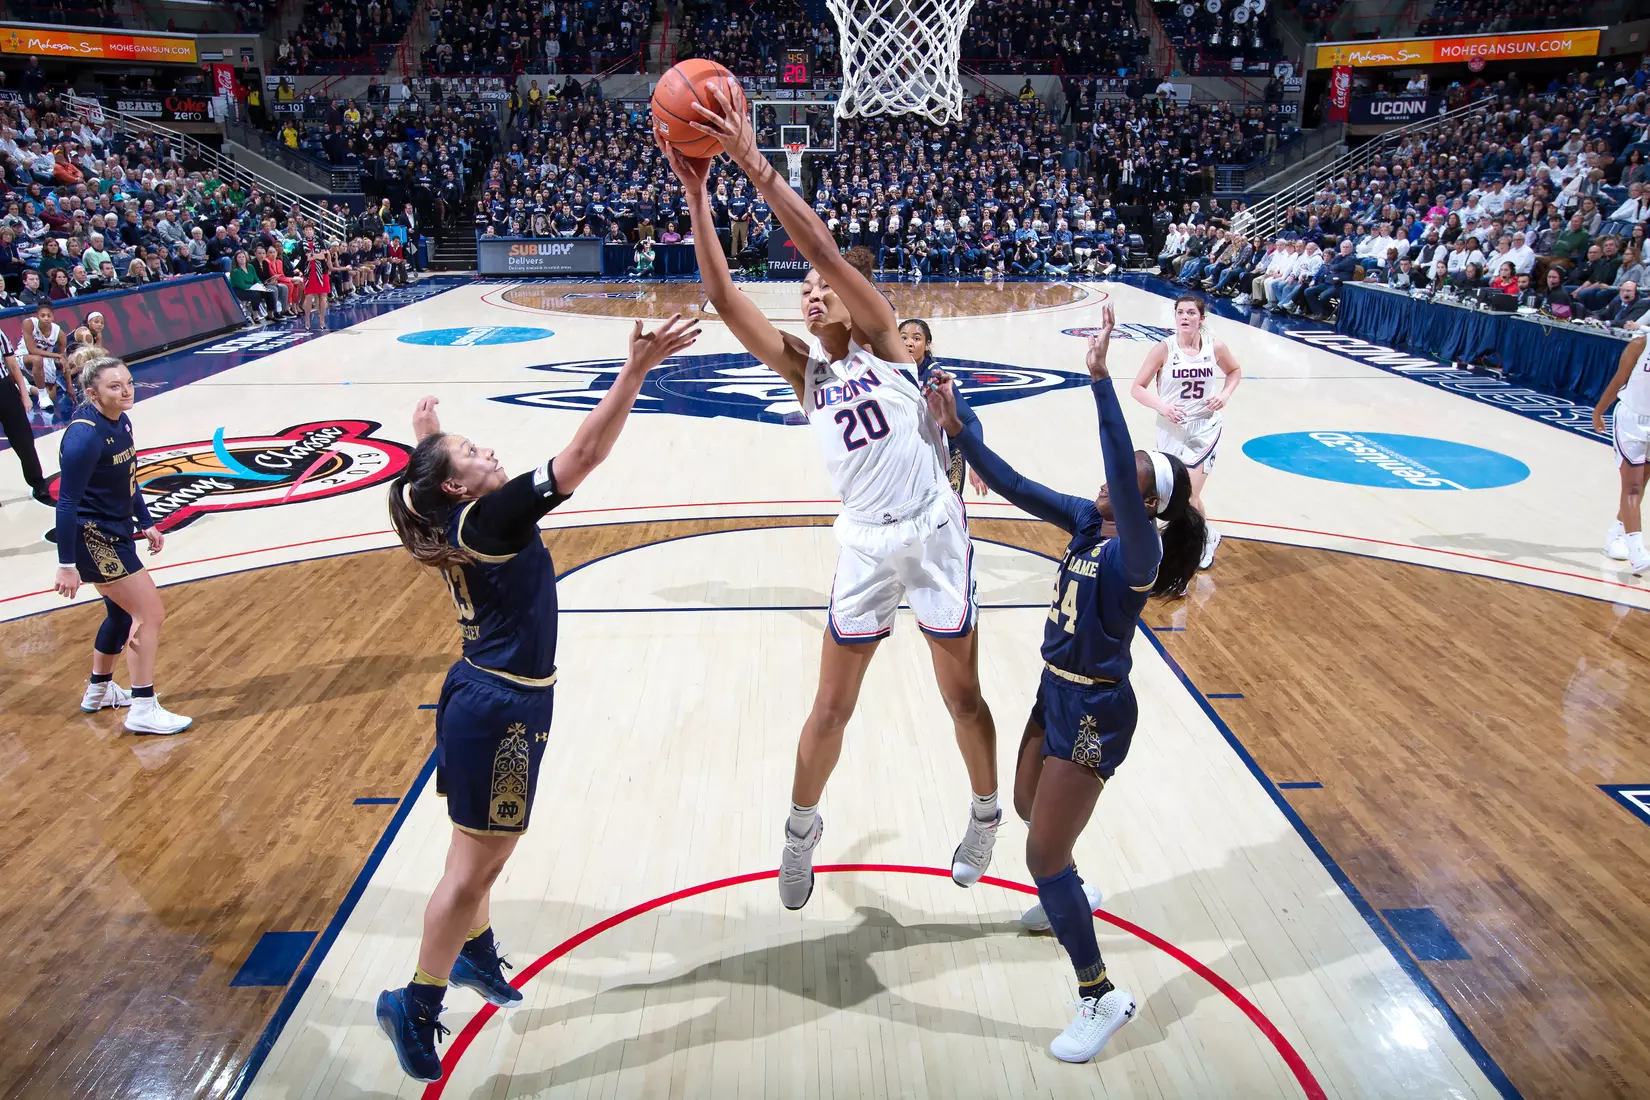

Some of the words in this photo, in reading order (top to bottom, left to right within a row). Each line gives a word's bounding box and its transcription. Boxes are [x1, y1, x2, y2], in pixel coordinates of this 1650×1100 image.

[28, 38, 79, 51] Mohegan
[79, 43, 104, 53] Sun
[109, 43, 191, 55] MOHEGANSUN.COM
[1440, 40, 1573, 57] MOHEGANSUN.COM
[788, 53, 809, 63] 4:51
[1347, 51, 1396, 62] Mohegan
[1397, 50, 1421, 61] Sun
[784, 64, 807, 83] 20
[117, 101, 163, 111] BEAR'S
[165, 97, 206, 112] Coke
[288, 103, 304, 112] 101
[1281, 104, 1297, 112] 105
[1370, 101, 1426, 115] UCONN
[174, 112, 202, 120] zero
[508, 243, 574, 256] SUBWAY
[508, 257, 543, 265] Delivers
[157, 276, 236, 332] SON
[1283, 329, 1460, 372] UCONN
[1172, 367, 1213, 379] UCONN
[813, 369, 882, 410] UCONN
[1180, 381, 1206, 400] 25
[834, 400, 891, 452] 20
[255, 426, 343, 468] Classic
[320, 450, 384, 486] 2019
[1067, 556, 1099, 578] DAME
[1048, 570, 1079, 634] 24
